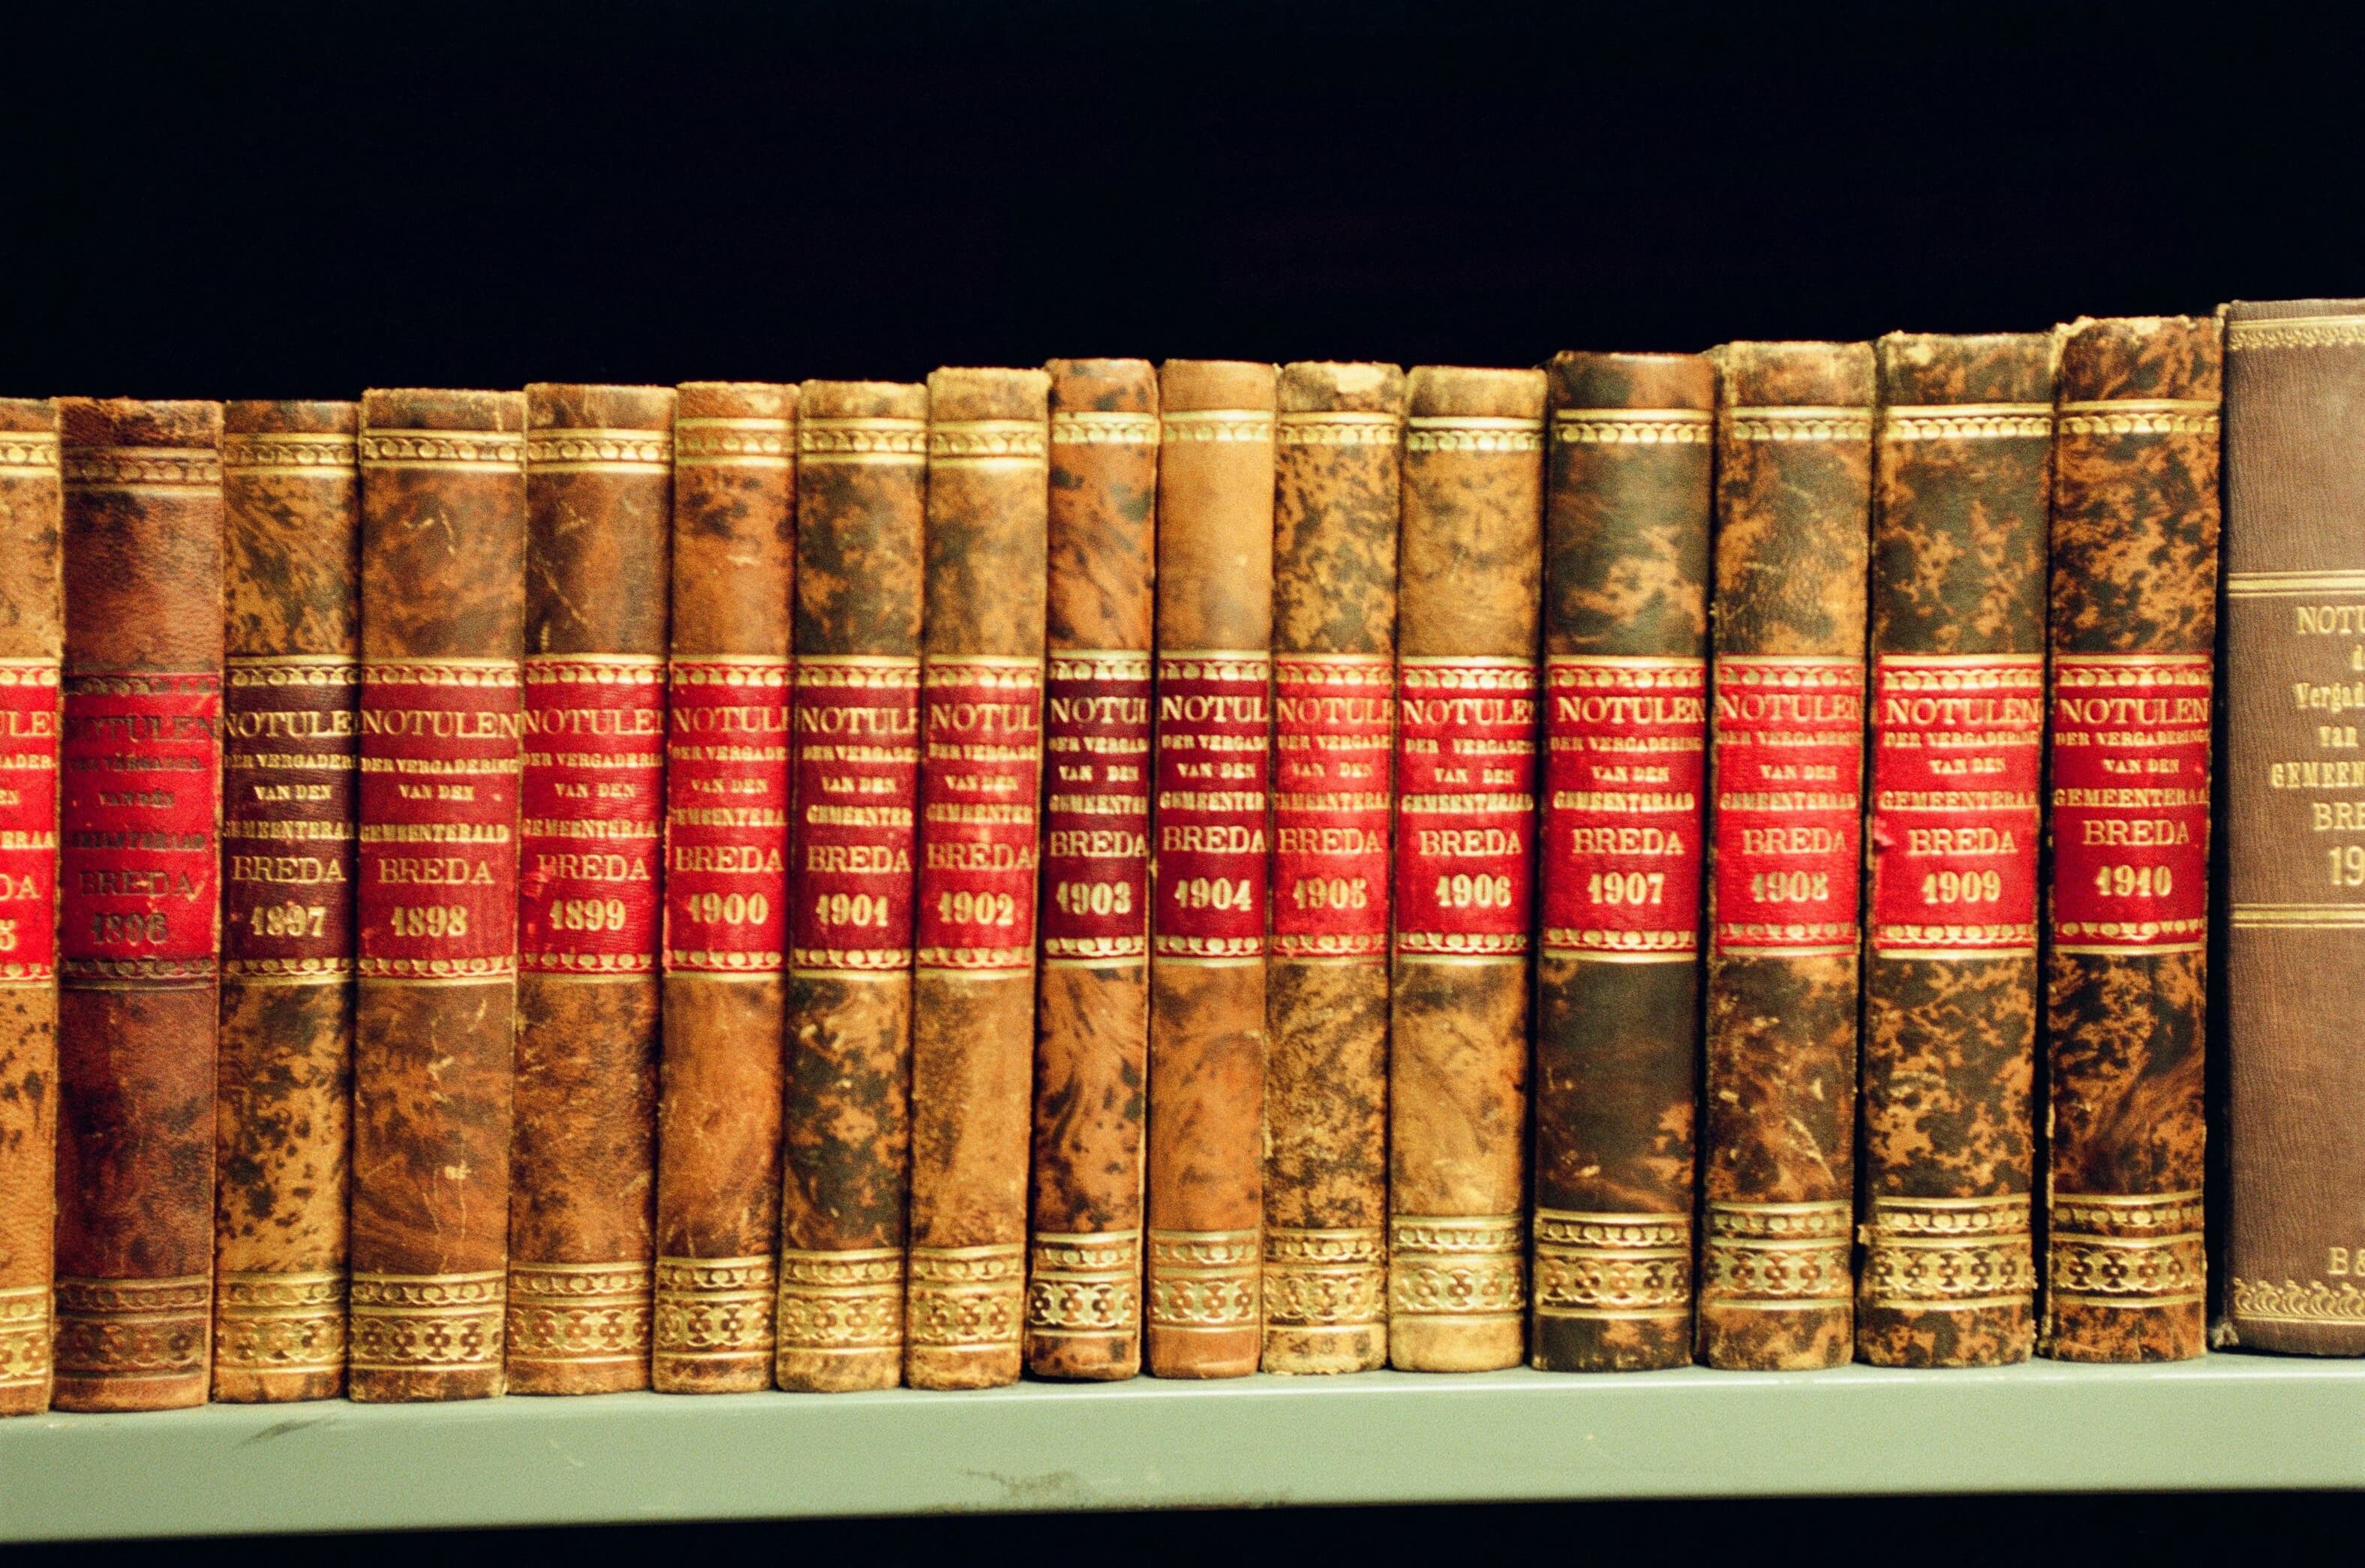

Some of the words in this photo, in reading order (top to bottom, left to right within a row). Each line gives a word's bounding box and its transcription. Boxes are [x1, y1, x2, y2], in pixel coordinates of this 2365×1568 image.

[361, 709, 522, 738] NOTULEN
[1557, 695, 1706, 724] NOTULEN
[1884, 697, 2040, 725] NOTULEN
[2059, 697, 2210, 725] NOTULEN
[1161, 734, 1195, 749] DER
[1405, 737, 1439, 755] DER
[1883, 731, 1922, 748] DER
[2055, 731, 2090, 746] DER
[2318, 725, 2359, 748] van
[361, 757, 395, 773] DER
[1059, 764, 1092, 781] VAN
[1176, 762, 1213, 778] VAN
[1291, 761, 1326, 777] VAN
[1434, 767, 1468, 783] VAN
[1483, 767, 1514, 785] DEN
[1591, 765, 1628, 782] VAN
[1632, 765, 1669, 782] DEN
[1759, 764, 1797, 779] VAN
[1803, 764, 1837, 780] DEN
[1929, 758, 1967, 775] VAN
[1973, 757, 2006, 773] DEN
[2102, 758, 2141, 774] VAN
[2147, 758, 2180, 773] DEN
[254, 784, 291, 801] VAN
[296, 784, 332, 801] DEN
[399, 784, 432, 799] VAN
[437, 785, 475, 801] DEN
[554, 782, 590, 798] VAN
[598, 782, 636, 798] DEN
[691, 778, 726, 793] VAN
[731, 778, 768, 795] DEN
[822, 776, 855, 793] VAN
[945, 774, 978, 791] VAN
[1050, 830, 1147, 858] BREDA
[1163, 825, 1267, 853] BREDA
[1278, 828, 1383, 855] BREDA
[1418, 828, 1523, 857] BREDA
[1571, 828, 1686, 855] BREDA
[1742, 827, 1847, 855] BREDA
[1907, 827, 2018, 856] BREDA
[2082, 819, 2189, 846] BREDA
[232, 855, 347, 884] BREDA
[537, 854, 652, 882] BREDA
[675, 845, 785, 873] BREDA
[806, 845, 912, 874] BREDA
[927, 842, 1034, 871] BREDA
[80, 870, 195, 897] BREDA
[378, 858, 495, 885] BREDA
[2095, 864, 2173, 897] 1910
[1056, 880, 1132, 915] 1903
[1174, 877, 1252, 911] 1904
[1293, 877, 1367, 910] 1905
[1435, 873, 1512, 909] 1906
[1587, 871, 1665, 905] 1907
[1750, 870, 1829, 903] 1908
[1921, 870, 2002, 905] 1909
[251, 905, 327, 938] 1897
[391, 905, 469, 937] 1898
[549, 898, 627, 932] 1899
[687, 891, 770, 925] 1900
[815, 893, 889, 927] 1901
[938, 891, 1014, 927] 1902
[91, 912, 168, 945] 1896
